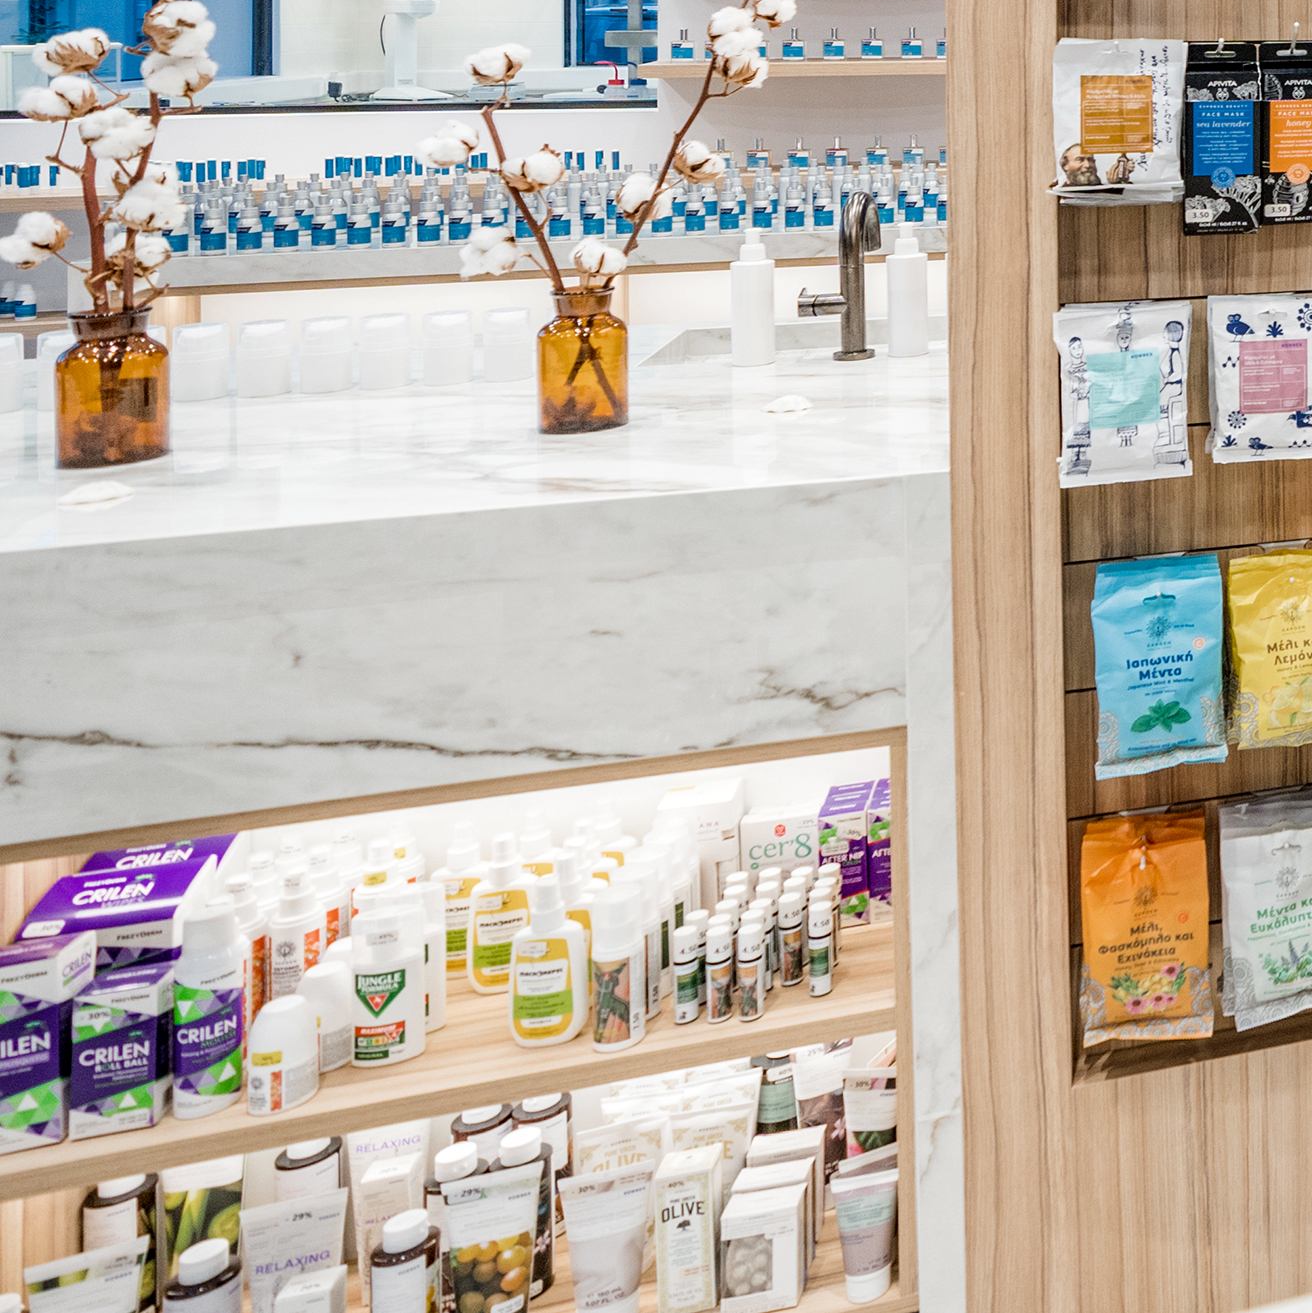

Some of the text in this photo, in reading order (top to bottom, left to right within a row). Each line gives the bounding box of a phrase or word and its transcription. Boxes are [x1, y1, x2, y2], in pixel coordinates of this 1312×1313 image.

[1208, 80, 1237, 88] APIVITA
[1284, 79, 1312, 87] APIVITA
[1212, 120, 1250, 128] lavender
[1286, 120, 1311, 128] honey
[1193, 211, 1209, 219] 3.50
[1267, 639, 1298, 654] Μέλι
[1127, 651, 1193, 669] Ιαπωνική
[1139, 667, 1182, 680] Μέντα
[116, 848, 193, 869] CRILEN
[72, 882, 154, 905] CRILEN
[1257, 903, 1296, 919] Μέντα
[1175, 933, 1194, 942] και
[62, 949, 92, 978] CRILEN
[1117, 947, 1176, 964] Εχινάκεια
[357, 972, 402, 989] JUNGLE
[177, 1016, 237, 1044] CRILEN
[79, 1041, 149, 1066] CRILEN
[661, 1202, 705, 1224] OLIVE
[255, 1250, 331, 1275] RELAXING
